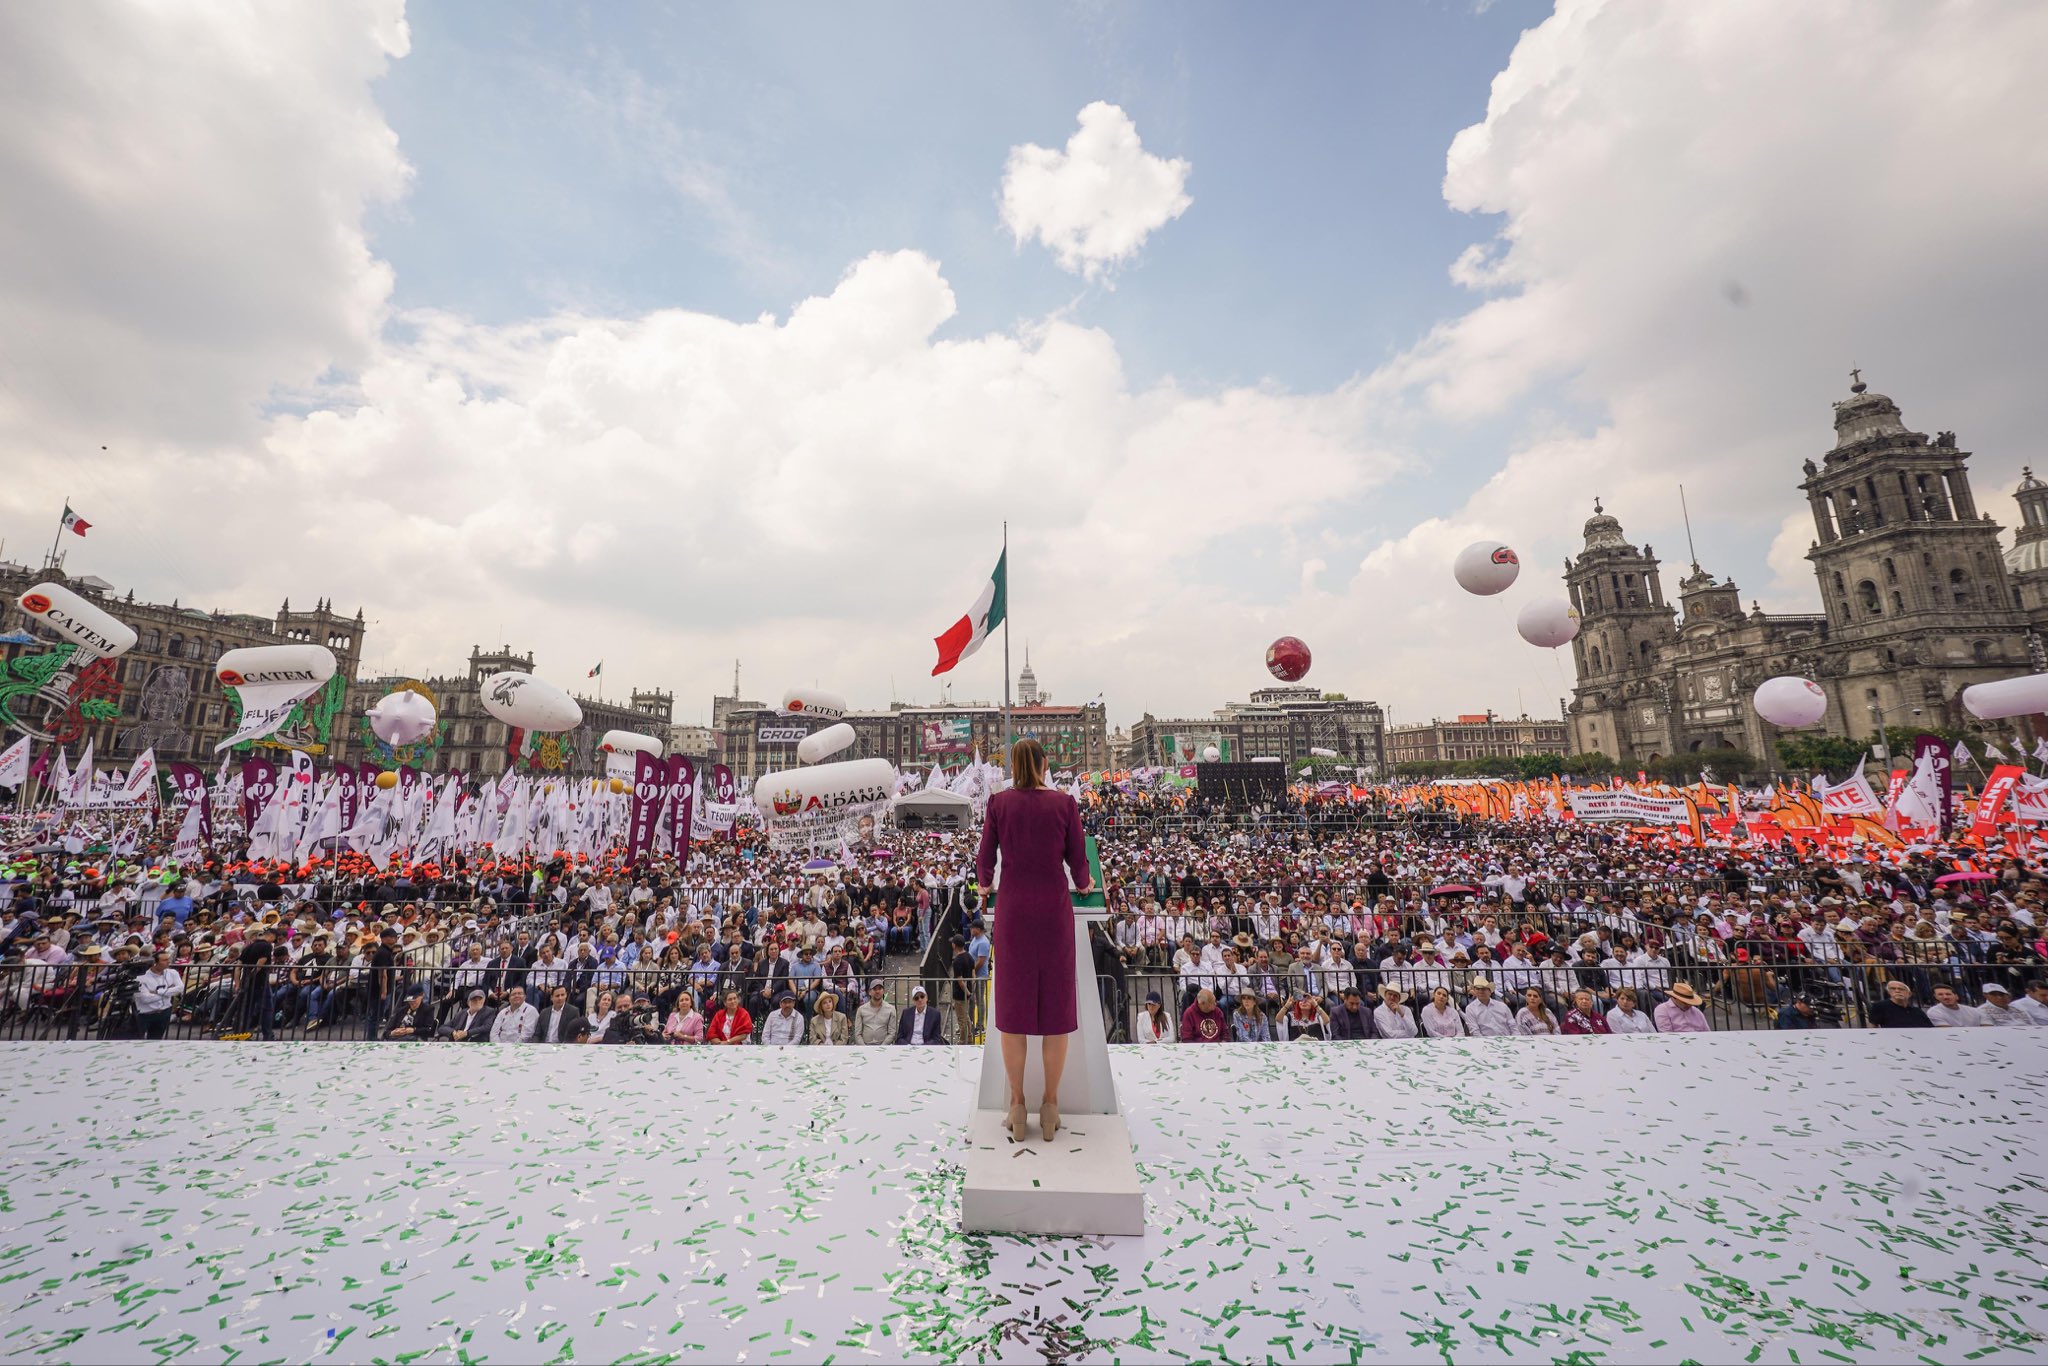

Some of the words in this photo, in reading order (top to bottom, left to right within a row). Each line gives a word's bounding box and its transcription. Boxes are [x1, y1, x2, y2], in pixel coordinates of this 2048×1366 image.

[47, 609, 117, 653] CATEM
[243, 670, 315, 683] CATEM
[804, 704, 843, 718] CATEM
[760, 730, 806, 740] CROC
[615, 747, 636, 757] CAT
[824, 786, 883, 799] RICARDO
[804, 792, 888, 812] ALDANA
